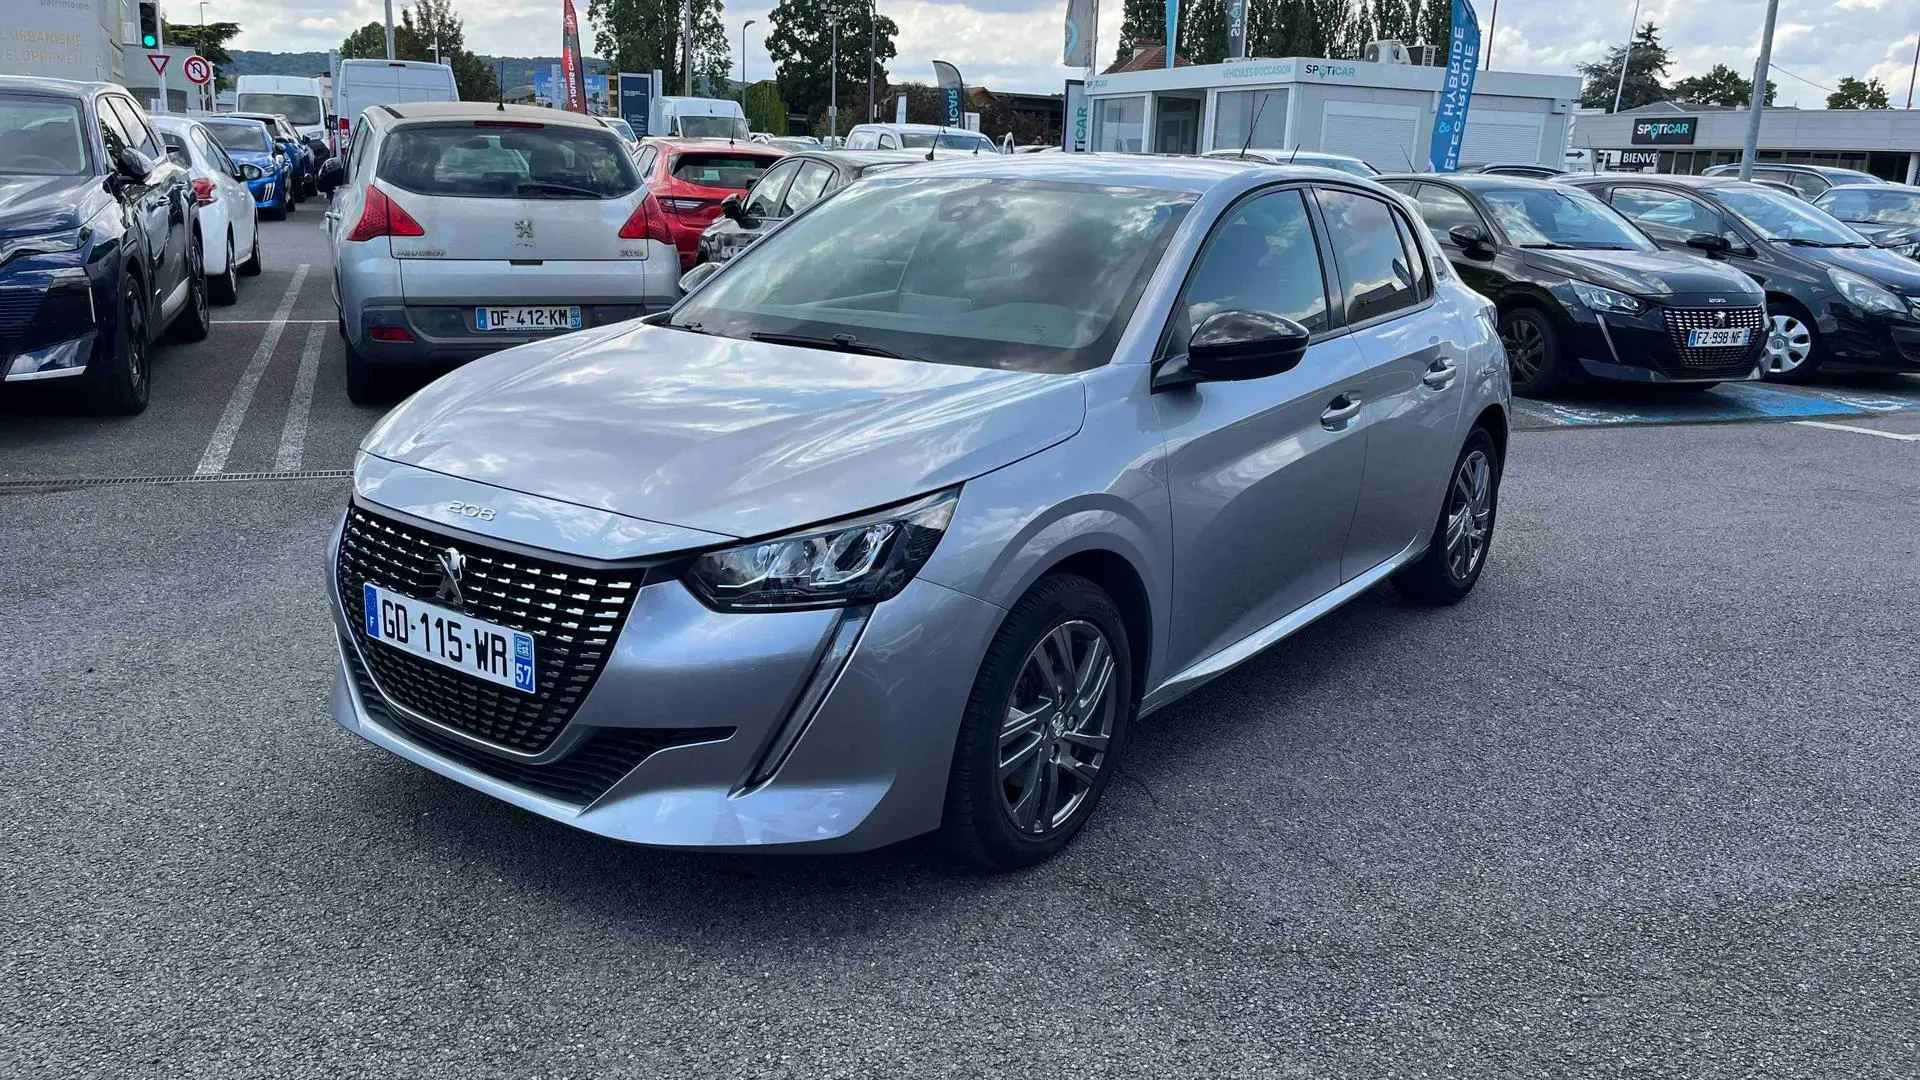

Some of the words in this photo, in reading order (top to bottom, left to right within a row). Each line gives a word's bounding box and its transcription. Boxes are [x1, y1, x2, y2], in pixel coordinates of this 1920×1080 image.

[1622, 153, 1657, 163] BIENVE
[490, 309, 568, 326] DF-412-KM
[1696, 331, 1742, 344] FZ-998-NF
[447, 500, 497, 522] 208
[382, 598, 507, 678] GD-115-WR
[515, 662, 532, 686] 57
